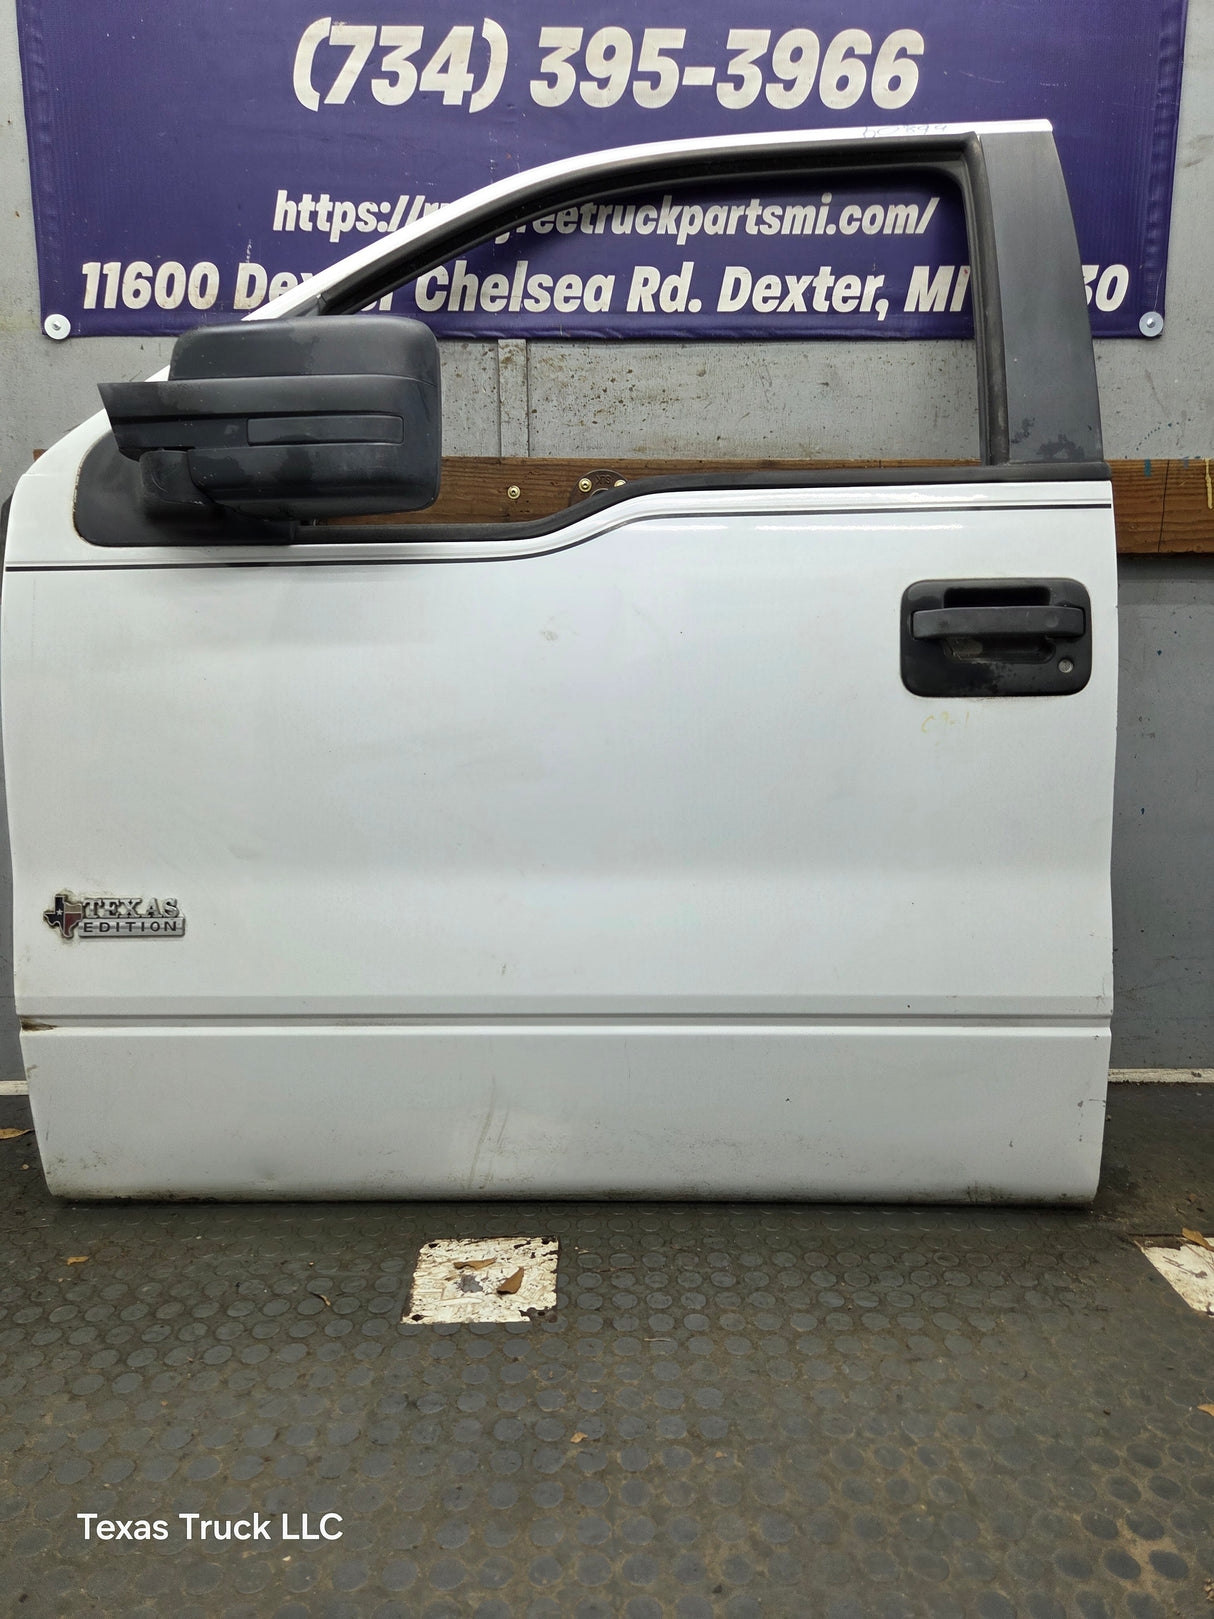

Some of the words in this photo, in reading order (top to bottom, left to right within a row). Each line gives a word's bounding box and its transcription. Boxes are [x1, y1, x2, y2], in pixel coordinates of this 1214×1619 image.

[292, 16, 509, 113] (734)
[529, 25, 925, 110] 395-3966
[81, 260, 220, 310] 11600
[415, 259, 616, 313] Chelsea
[626, 261, 703, 313] Rd.
[716, 265, 889, 322] Dexter,
[903, 265, 971, 312] MI
[82, 897, 180, 919] TEXAS
[83, 920, 177, 933] EDITION
